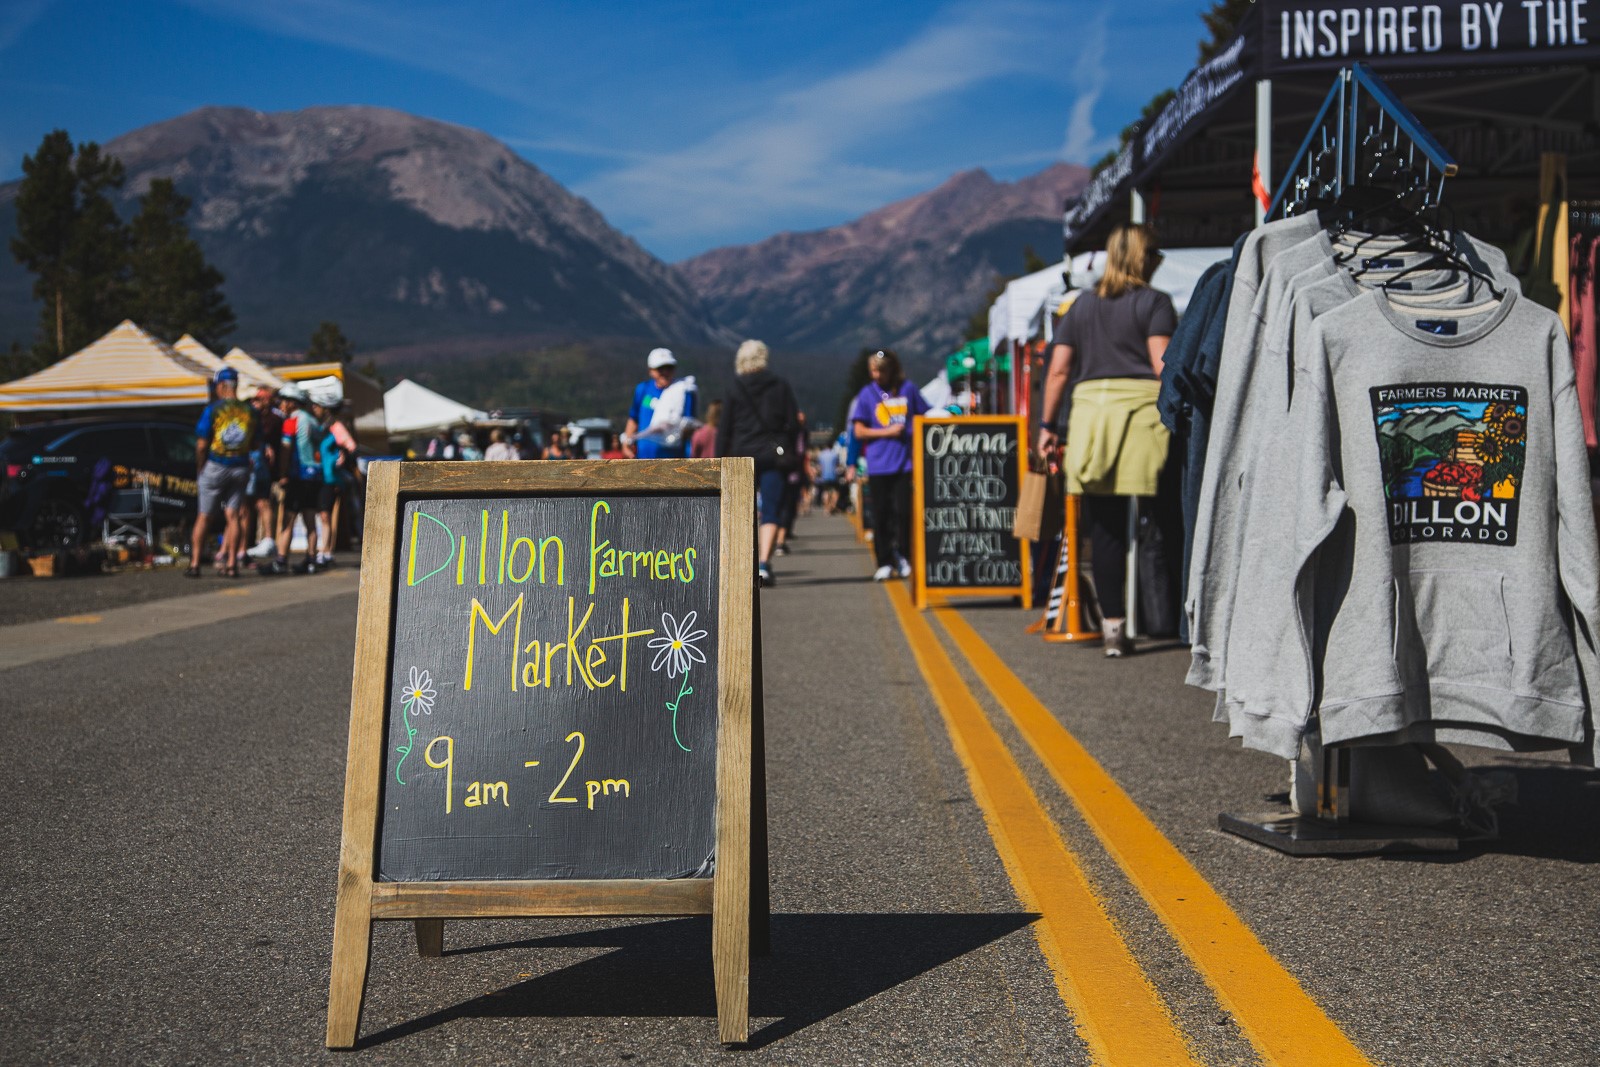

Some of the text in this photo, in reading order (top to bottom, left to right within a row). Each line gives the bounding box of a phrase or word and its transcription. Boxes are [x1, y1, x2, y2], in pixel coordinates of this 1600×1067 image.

[1280, 0, 1589, 59] INSPIRED BY THE
[1378, 386, 1521, 402] FARMERS MARKET
[933, 455, 1007, 479] LOCALLY
[933, 478, 1007, 503] DESIGNED
[1393, 500, 1508, 527] DILLON
[1392, 526, 1509, 542] COLORADO
[407, 509, 564, 586] Dillon
